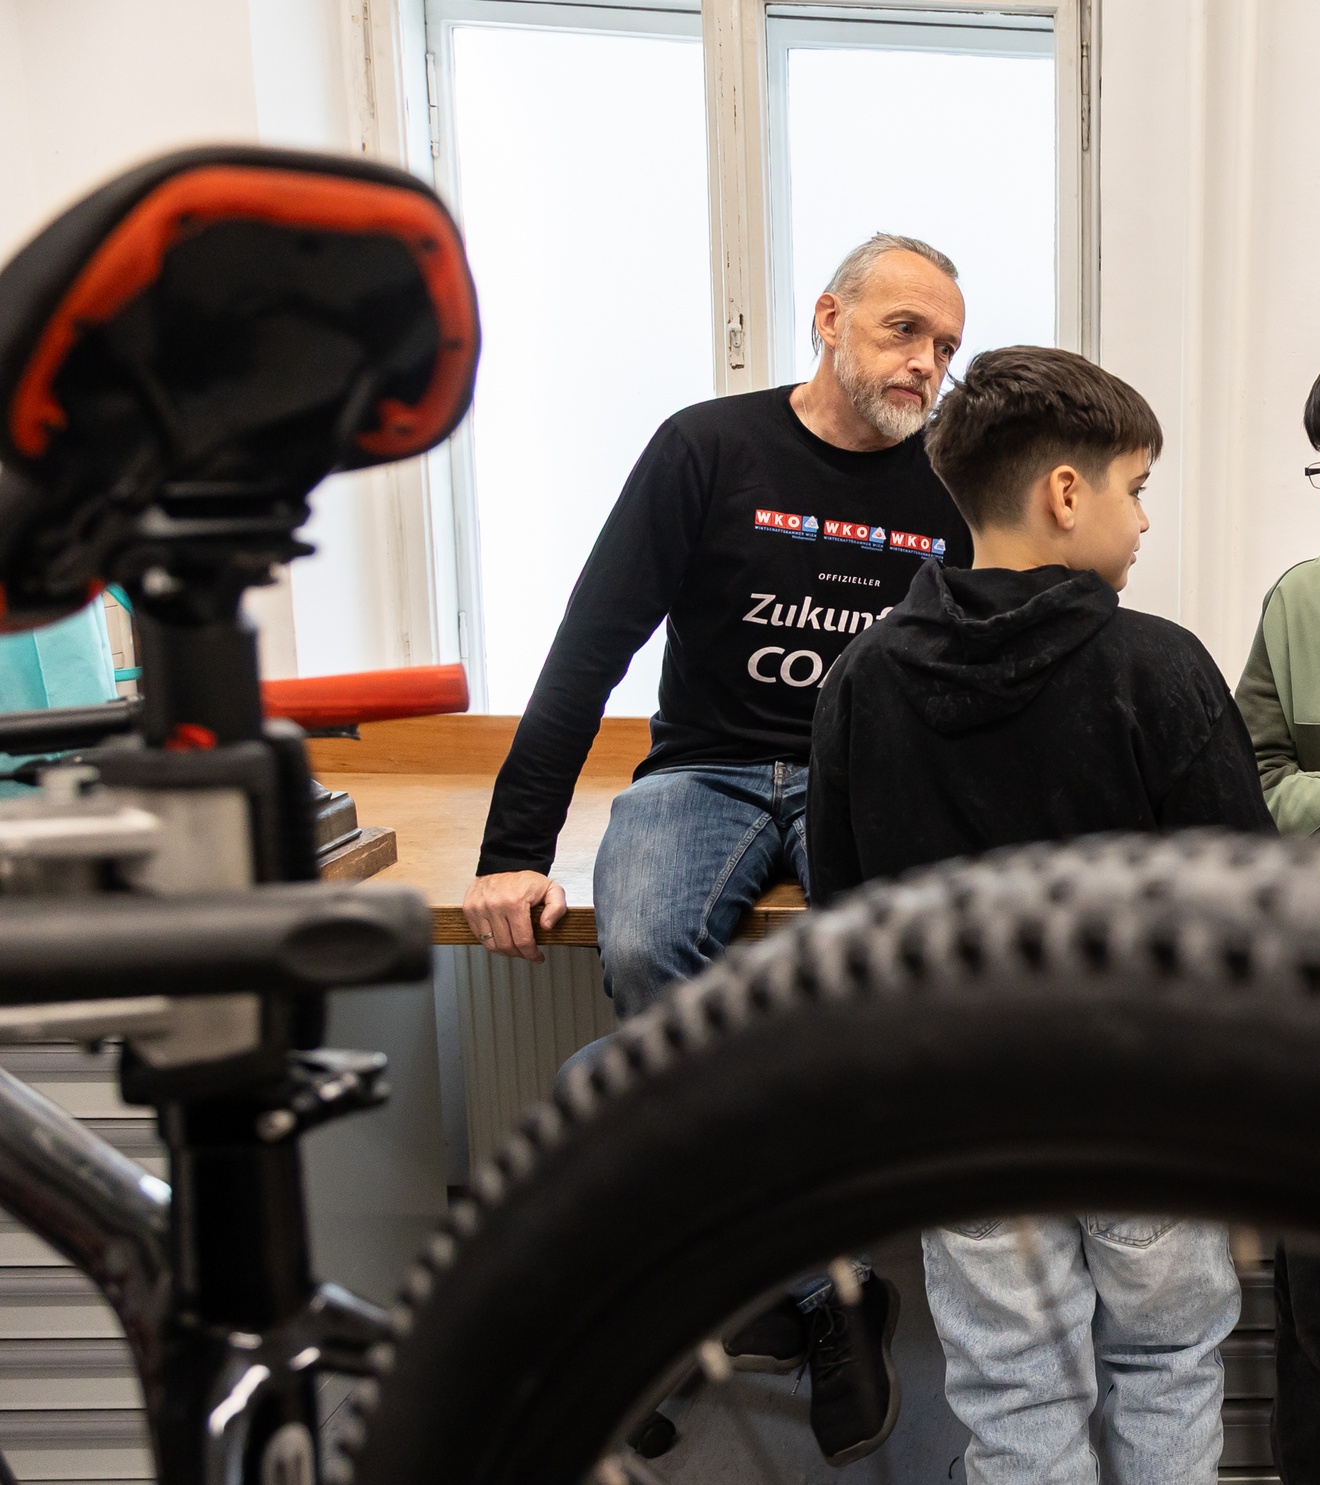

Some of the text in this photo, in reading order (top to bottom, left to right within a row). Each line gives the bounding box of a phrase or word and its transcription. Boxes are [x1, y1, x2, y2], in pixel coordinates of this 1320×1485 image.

[757, 511, 801, 528] WKO
[825, 521, 868, 539] WKO
[891, 532, 931, 550] WKO
[818, 572, 881, 587] OFFIZIELLER
[747, 646, 841, 688] CO
